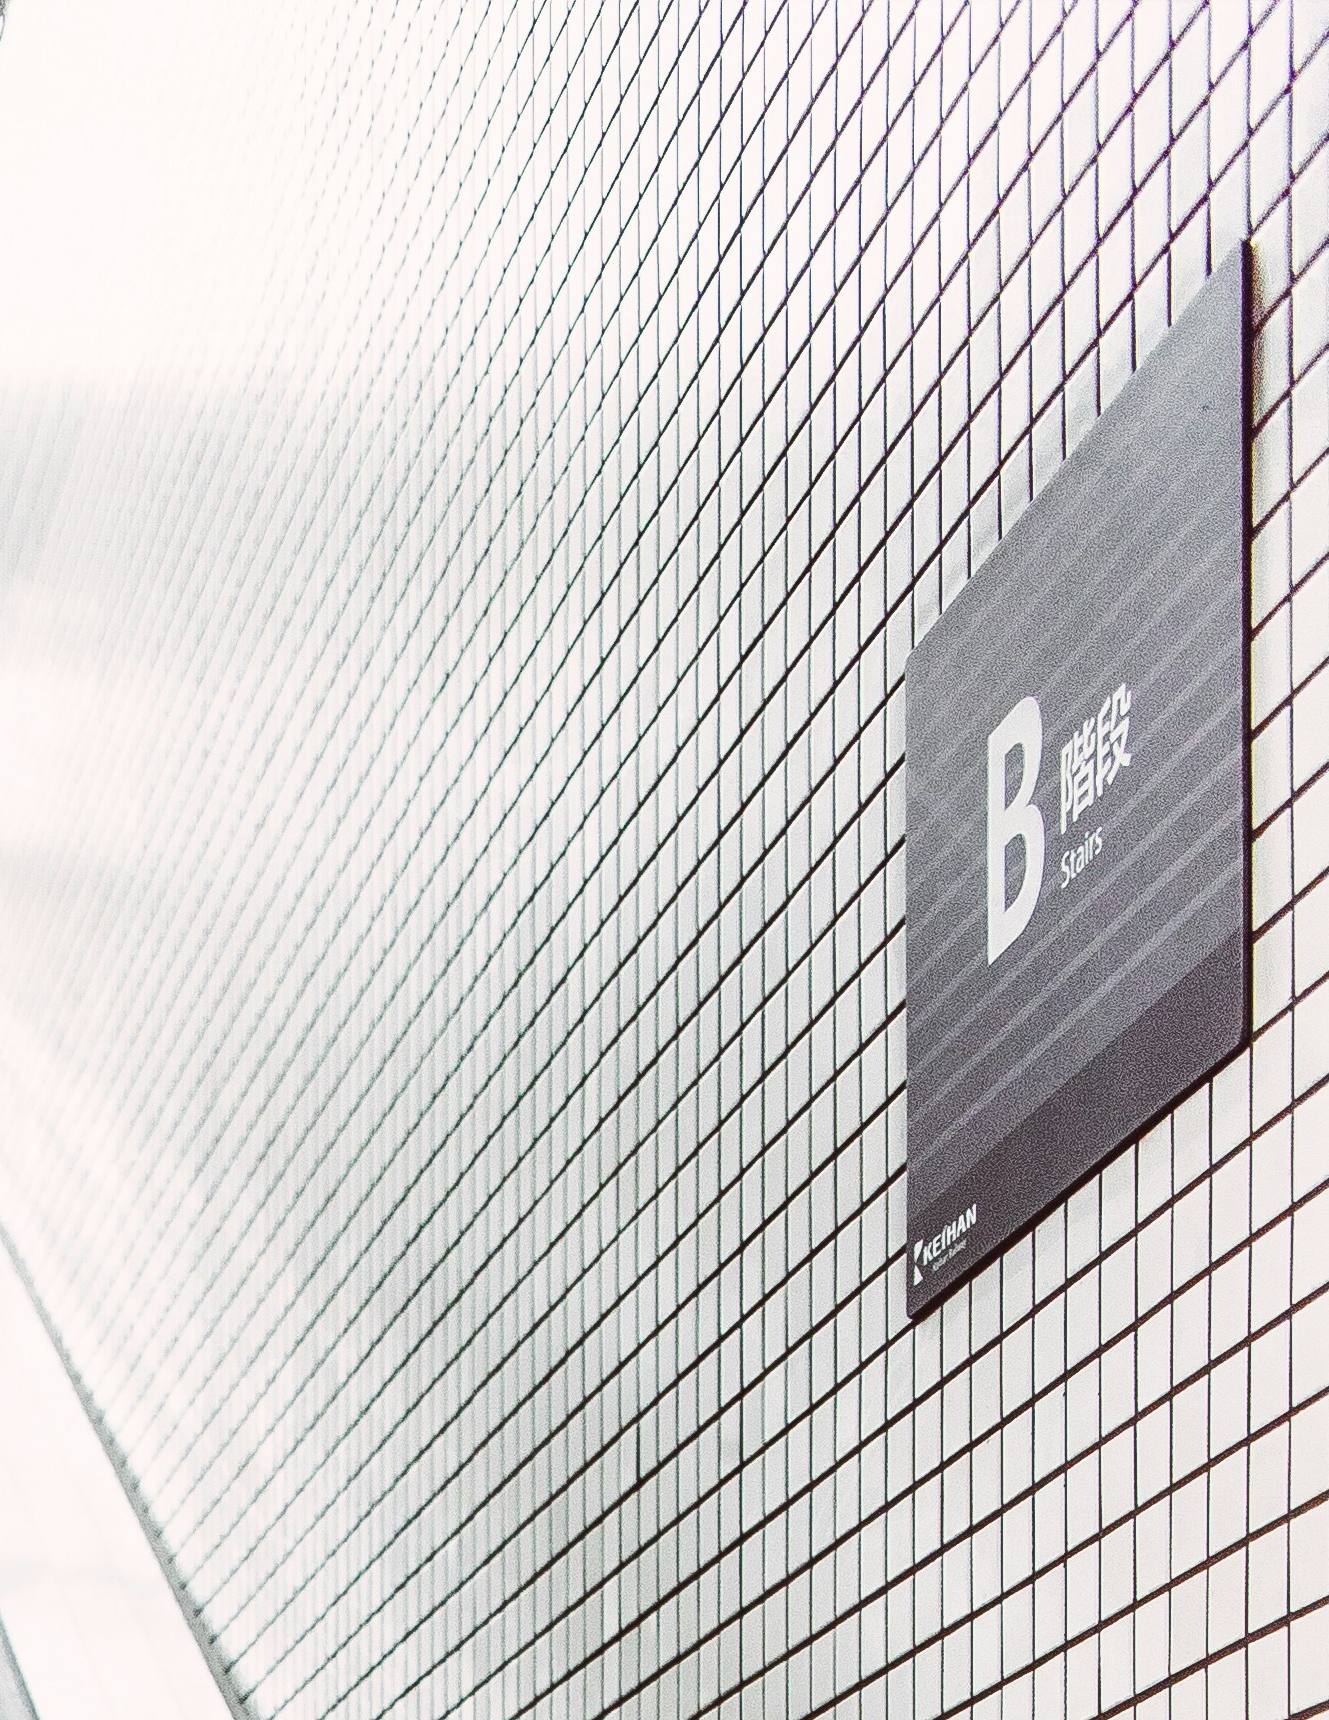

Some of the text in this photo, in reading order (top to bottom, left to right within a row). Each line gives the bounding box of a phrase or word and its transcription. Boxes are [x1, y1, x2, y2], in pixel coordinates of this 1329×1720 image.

[1060, 682, 1132, 834] 階段
[987, 696, 1044, 965] B
[1061, 827, 1103, 889] Stairs
[922, 1203, 977, 1267] KEIHAN
